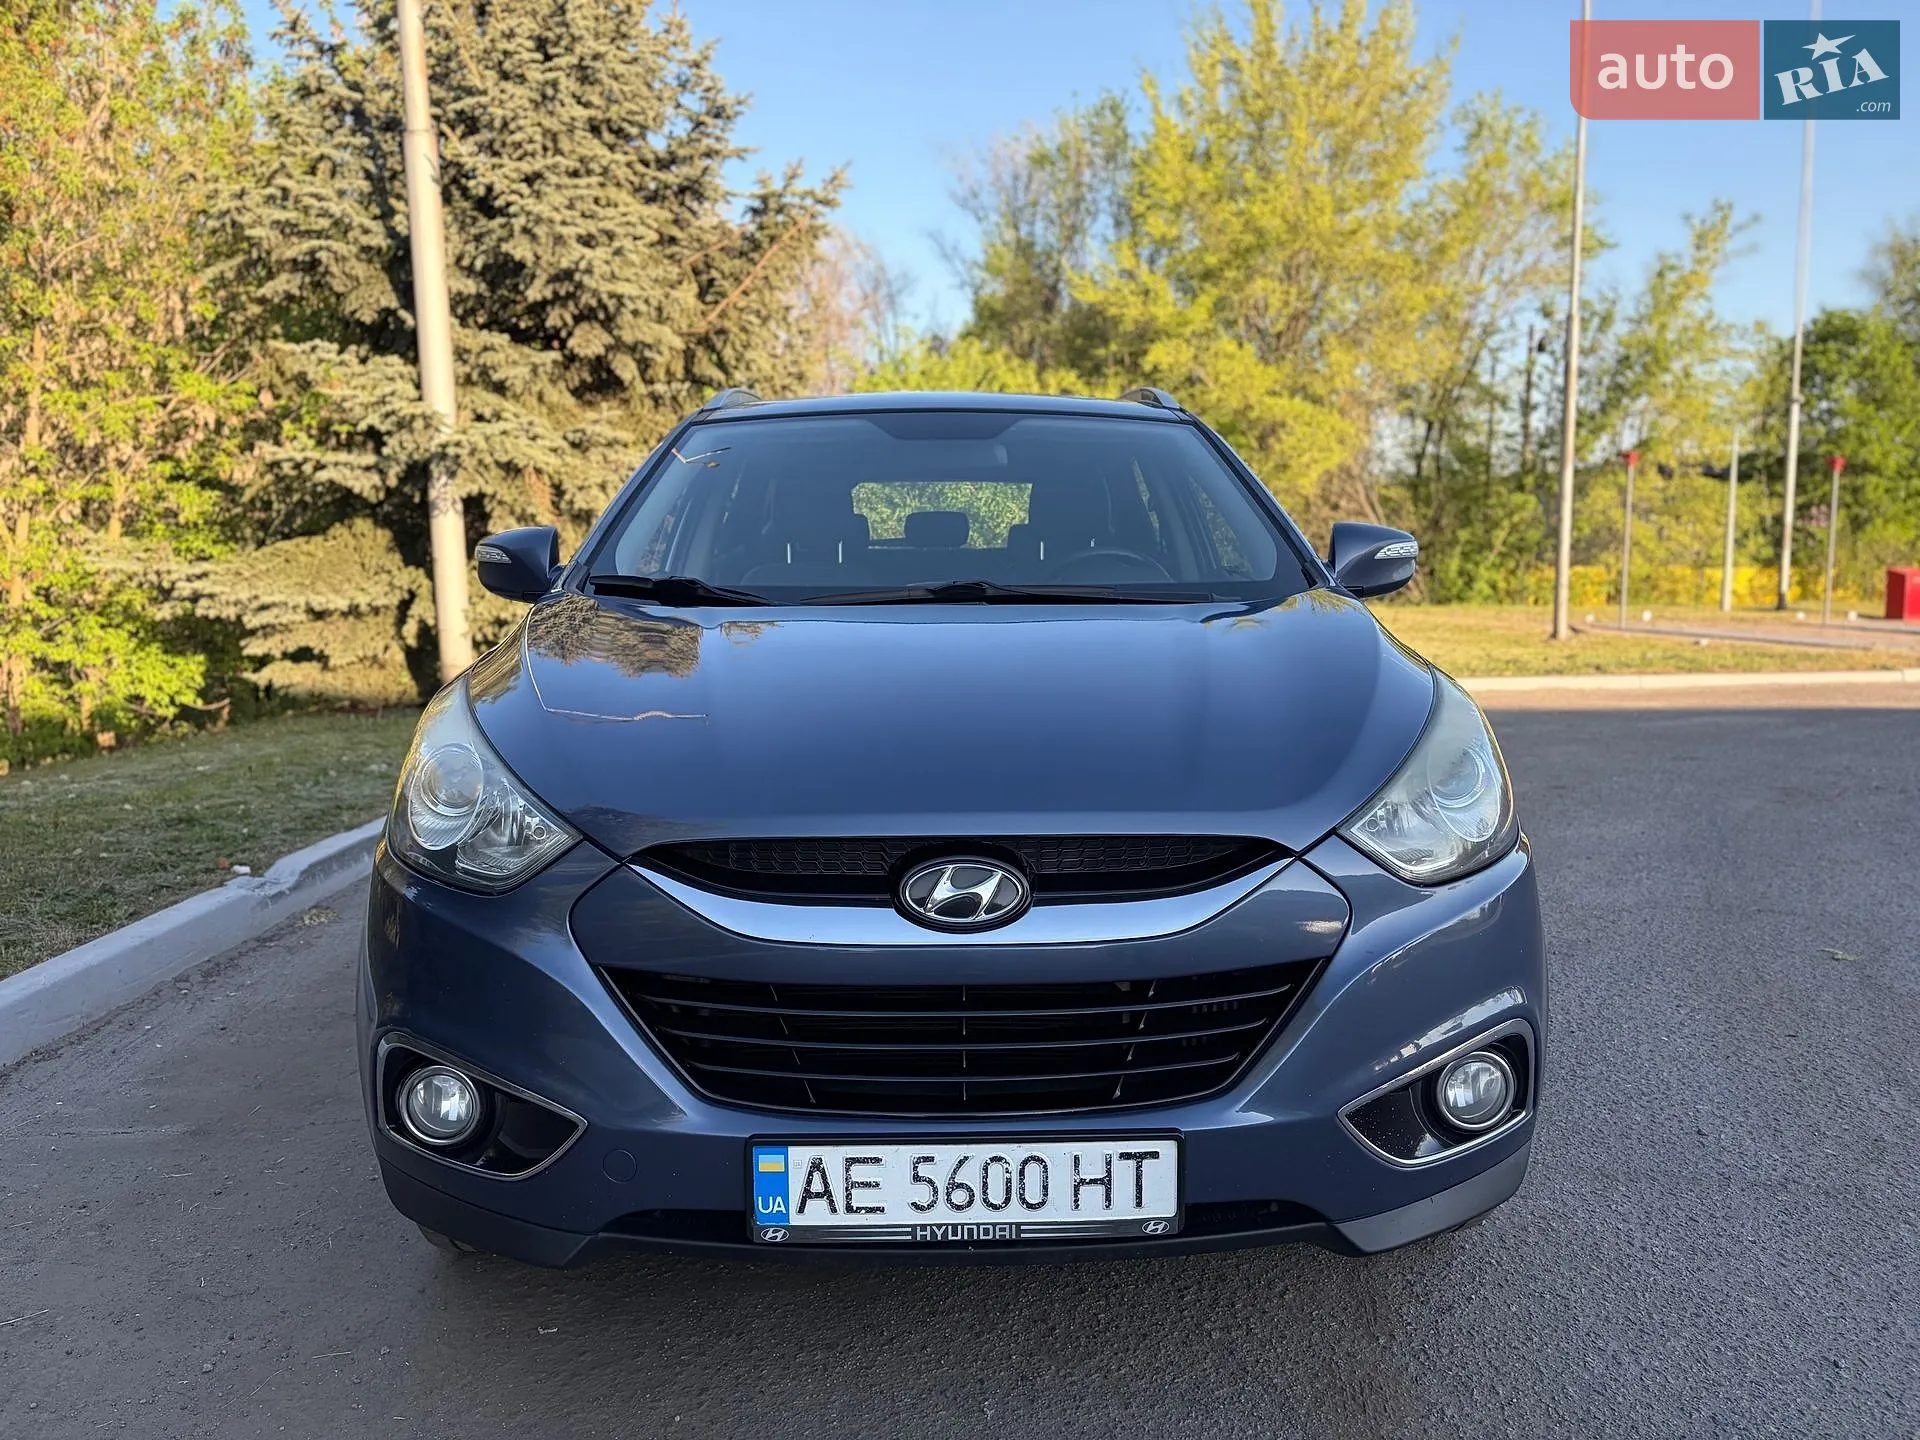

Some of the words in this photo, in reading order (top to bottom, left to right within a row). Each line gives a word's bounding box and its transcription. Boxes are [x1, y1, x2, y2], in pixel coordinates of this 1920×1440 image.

[797, 1155, 886, 1215] AE
[908, 1152, 1049, 1213] 5600
[1071, 1150, 1160, 1211] HT
[758, 1196, 786, 1214] UA
[916, 1224, 1016, 1241] HYUNDAI
